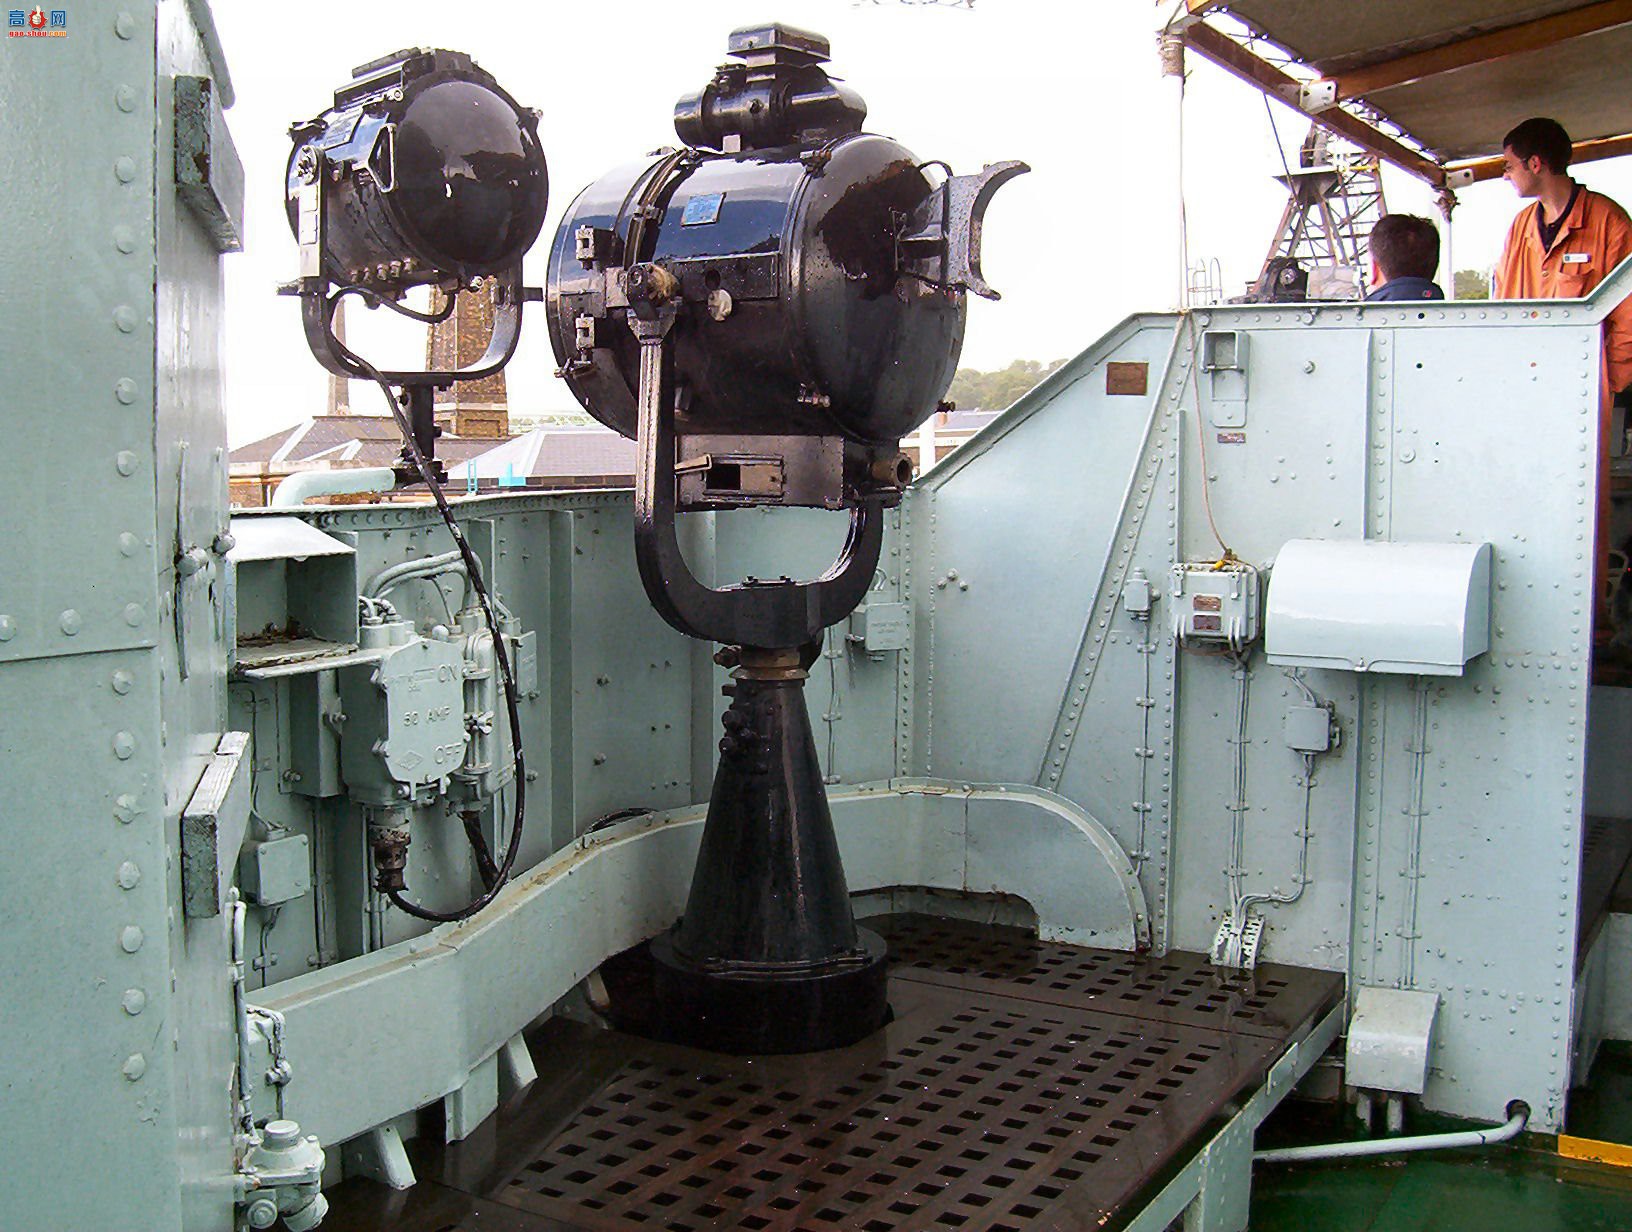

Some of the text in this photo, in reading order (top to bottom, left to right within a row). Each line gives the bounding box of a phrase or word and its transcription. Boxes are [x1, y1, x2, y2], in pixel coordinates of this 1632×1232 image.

[438, 664, 458, 683] ON
[426, 705, 450, 724] AMP
[435, 742, 462, 765] OFF
